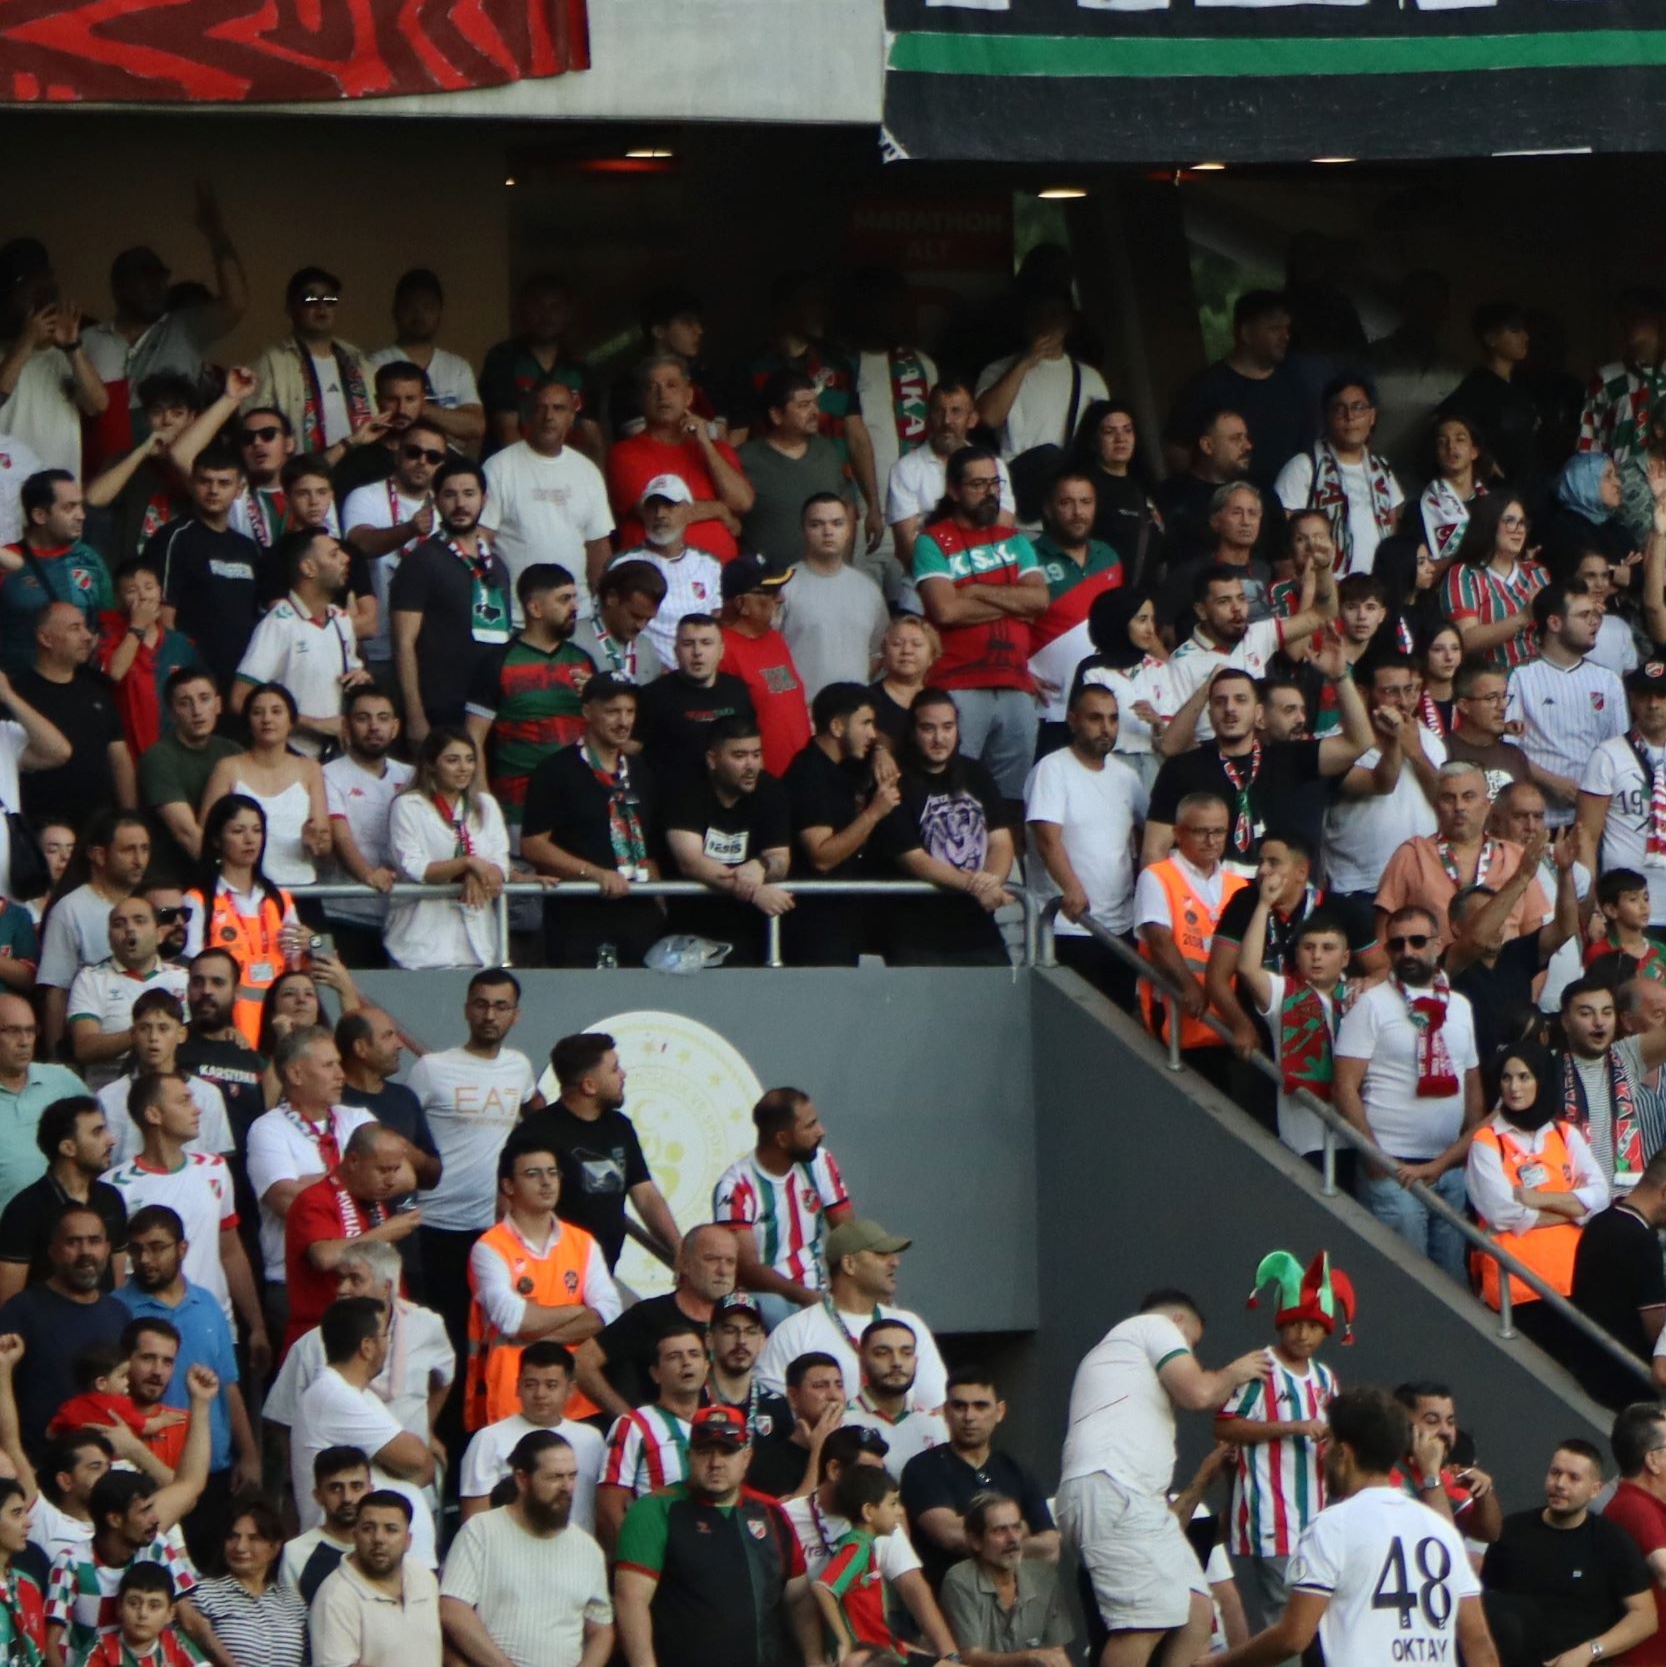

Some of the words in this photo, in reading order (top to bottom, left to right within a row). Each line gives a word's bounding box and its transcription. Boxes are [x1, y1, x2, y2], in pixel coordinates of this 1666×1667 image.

[853, 211, 1005, 233] MARATHON
[905, 240, 949, 261] ALT
[1371, 1534, 1452, 1631] 48
[1392, 1638, 1448, 1663] OKTAY
